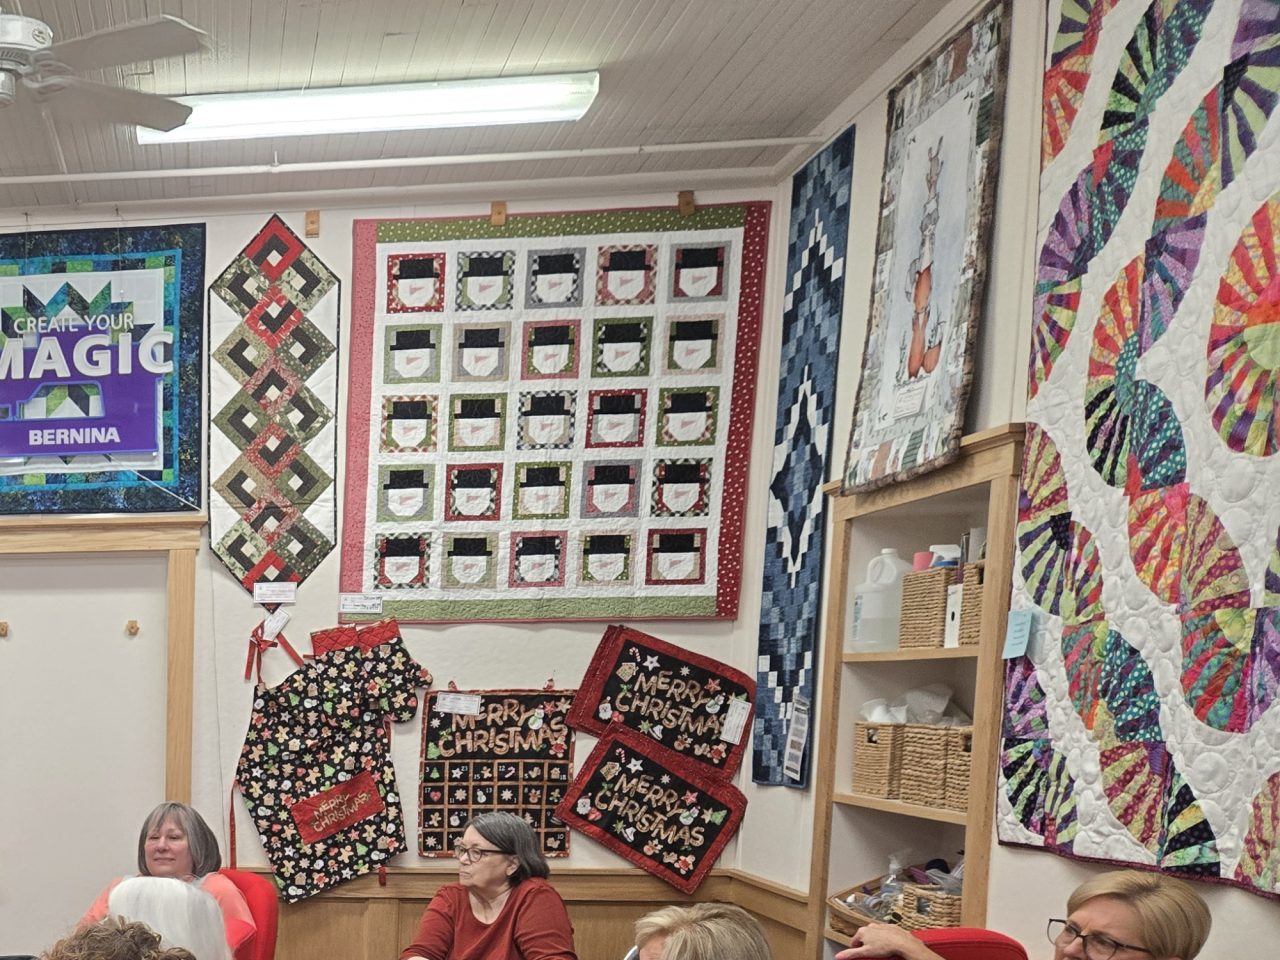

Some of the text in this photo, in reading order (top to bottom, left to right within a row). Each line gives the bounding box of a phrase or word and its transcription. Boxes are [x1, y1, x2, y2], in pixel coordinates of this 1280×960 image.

[14, 313, 134, 333] CREATE YOUR
[29, 427, 120, 445] BERNINA
[634, 670, 711, 709] MERRY
[439, 716, 568, 757] CHRISTMAS
[313, 793, 350, 820] MERRY
[313, 792, 368, 832] CHRISTMAS
[614, 773, 686, 817] MERRY
[594, 790, 705, 847] CHRISTMAS
